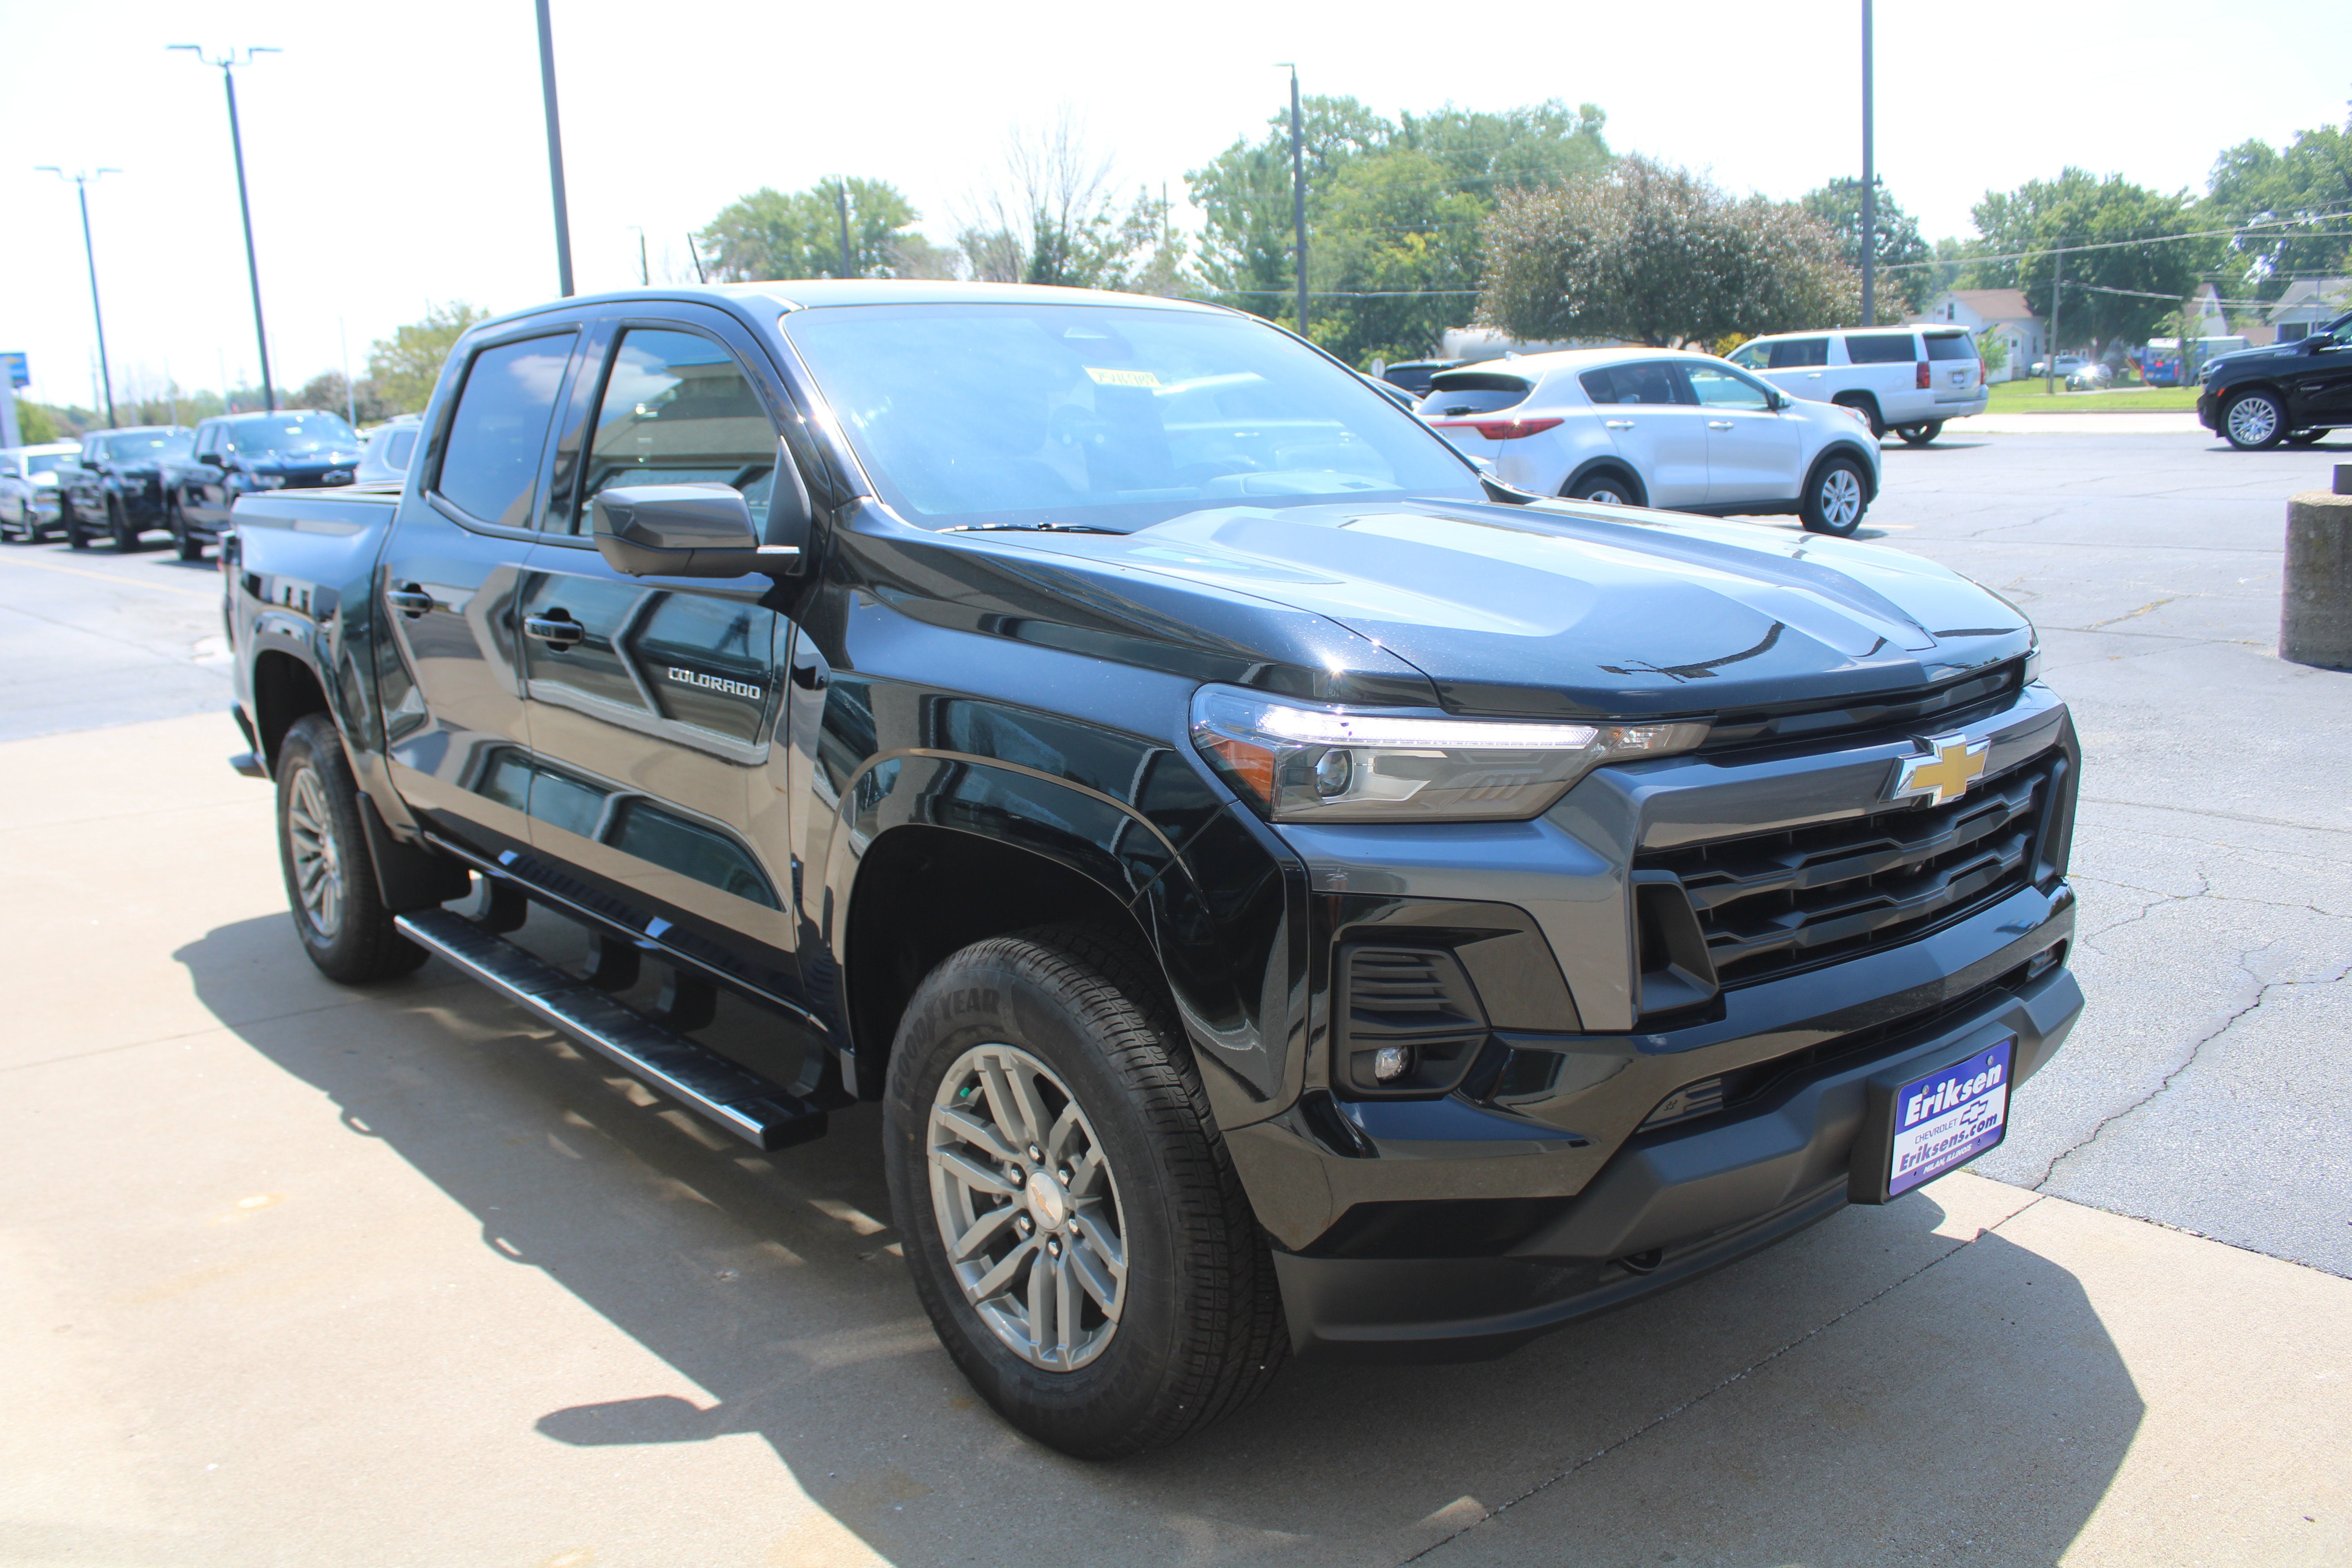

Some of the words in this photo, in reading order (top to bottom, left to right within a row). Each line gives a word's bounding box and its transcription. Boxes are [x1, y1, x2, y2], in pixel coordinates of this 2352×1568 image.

[668, 667, 760, 699] COLORADO
[1904, 1063, 2002, 1127] Eriksen
[1899, 1113, 1998, 1173] Eriksens.com
[1915, 1118, 1958, 1145] CHEVROLET
[1922, 1157, 1945, 1174] MILAN,
[1946, 1143, 1973, 1163] ILLINOIS
